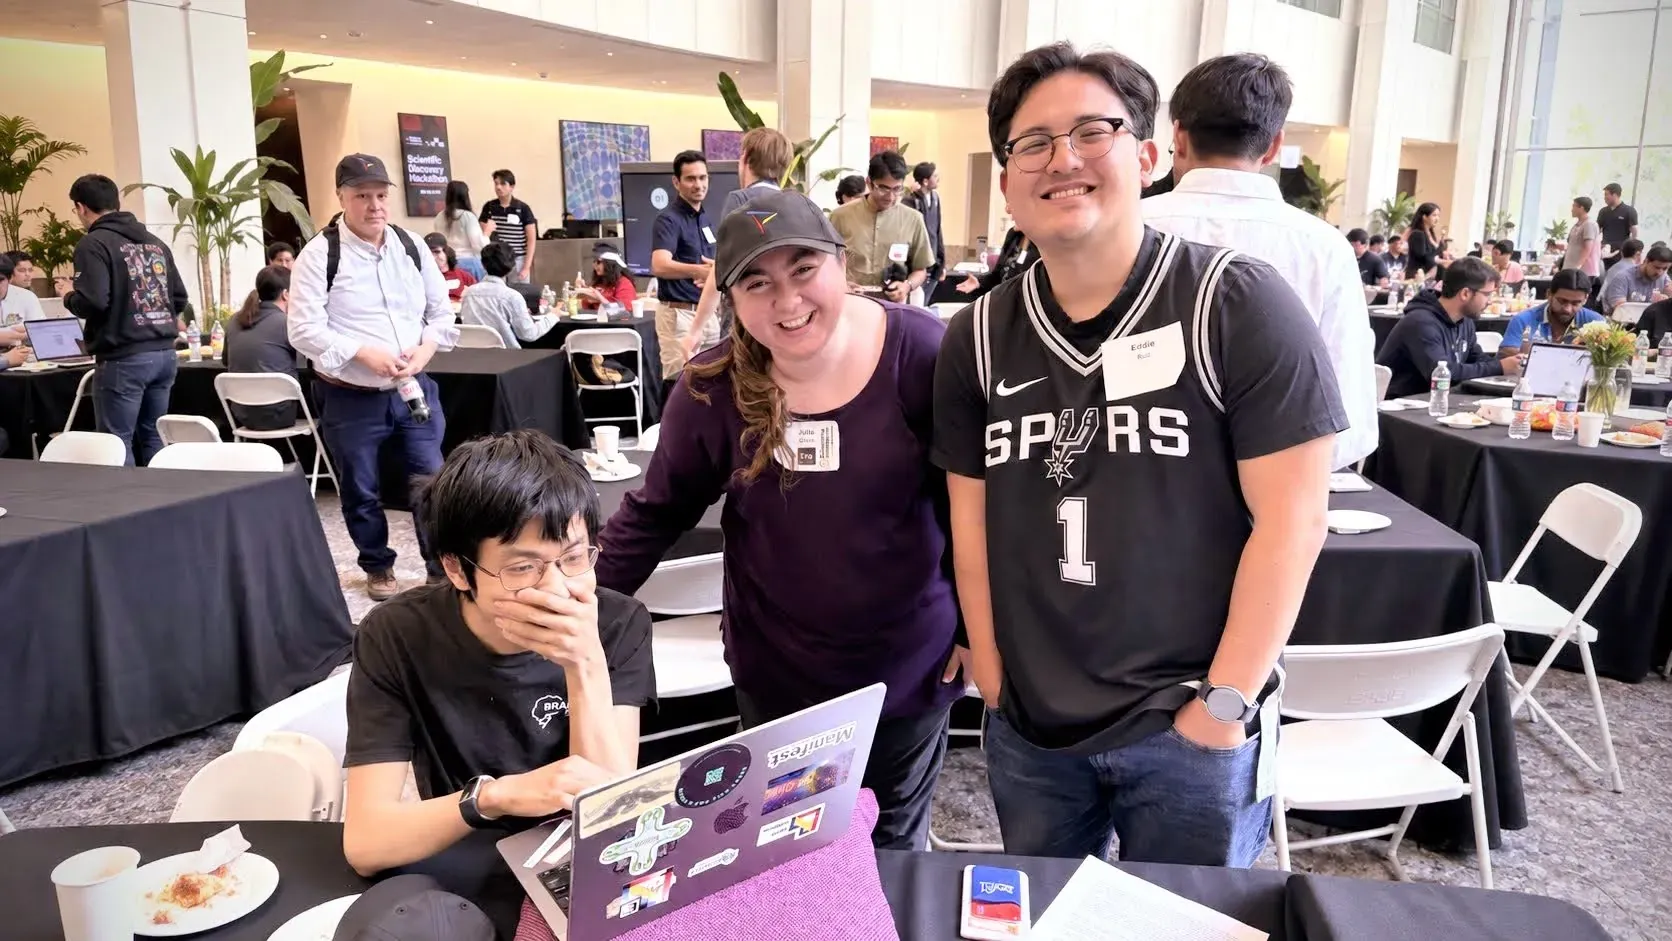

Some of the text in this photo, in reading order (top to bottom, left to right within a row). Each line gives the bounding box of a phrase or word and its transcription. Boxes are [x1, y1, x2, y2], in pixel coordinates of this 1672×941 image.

[407, 154, 442, 165] Scientific
[408, 164, 444, 176] Discovery
[409, 174, 448, 183] Hackathon
[1131, 341, 1155, 351] Eddie
[985, 405, 1190, 486] SPURS
[1056, 496, 1096, 586] 1
[543, 700, 570, 711] BRA
[769, 726, 854, 768] Manifest
